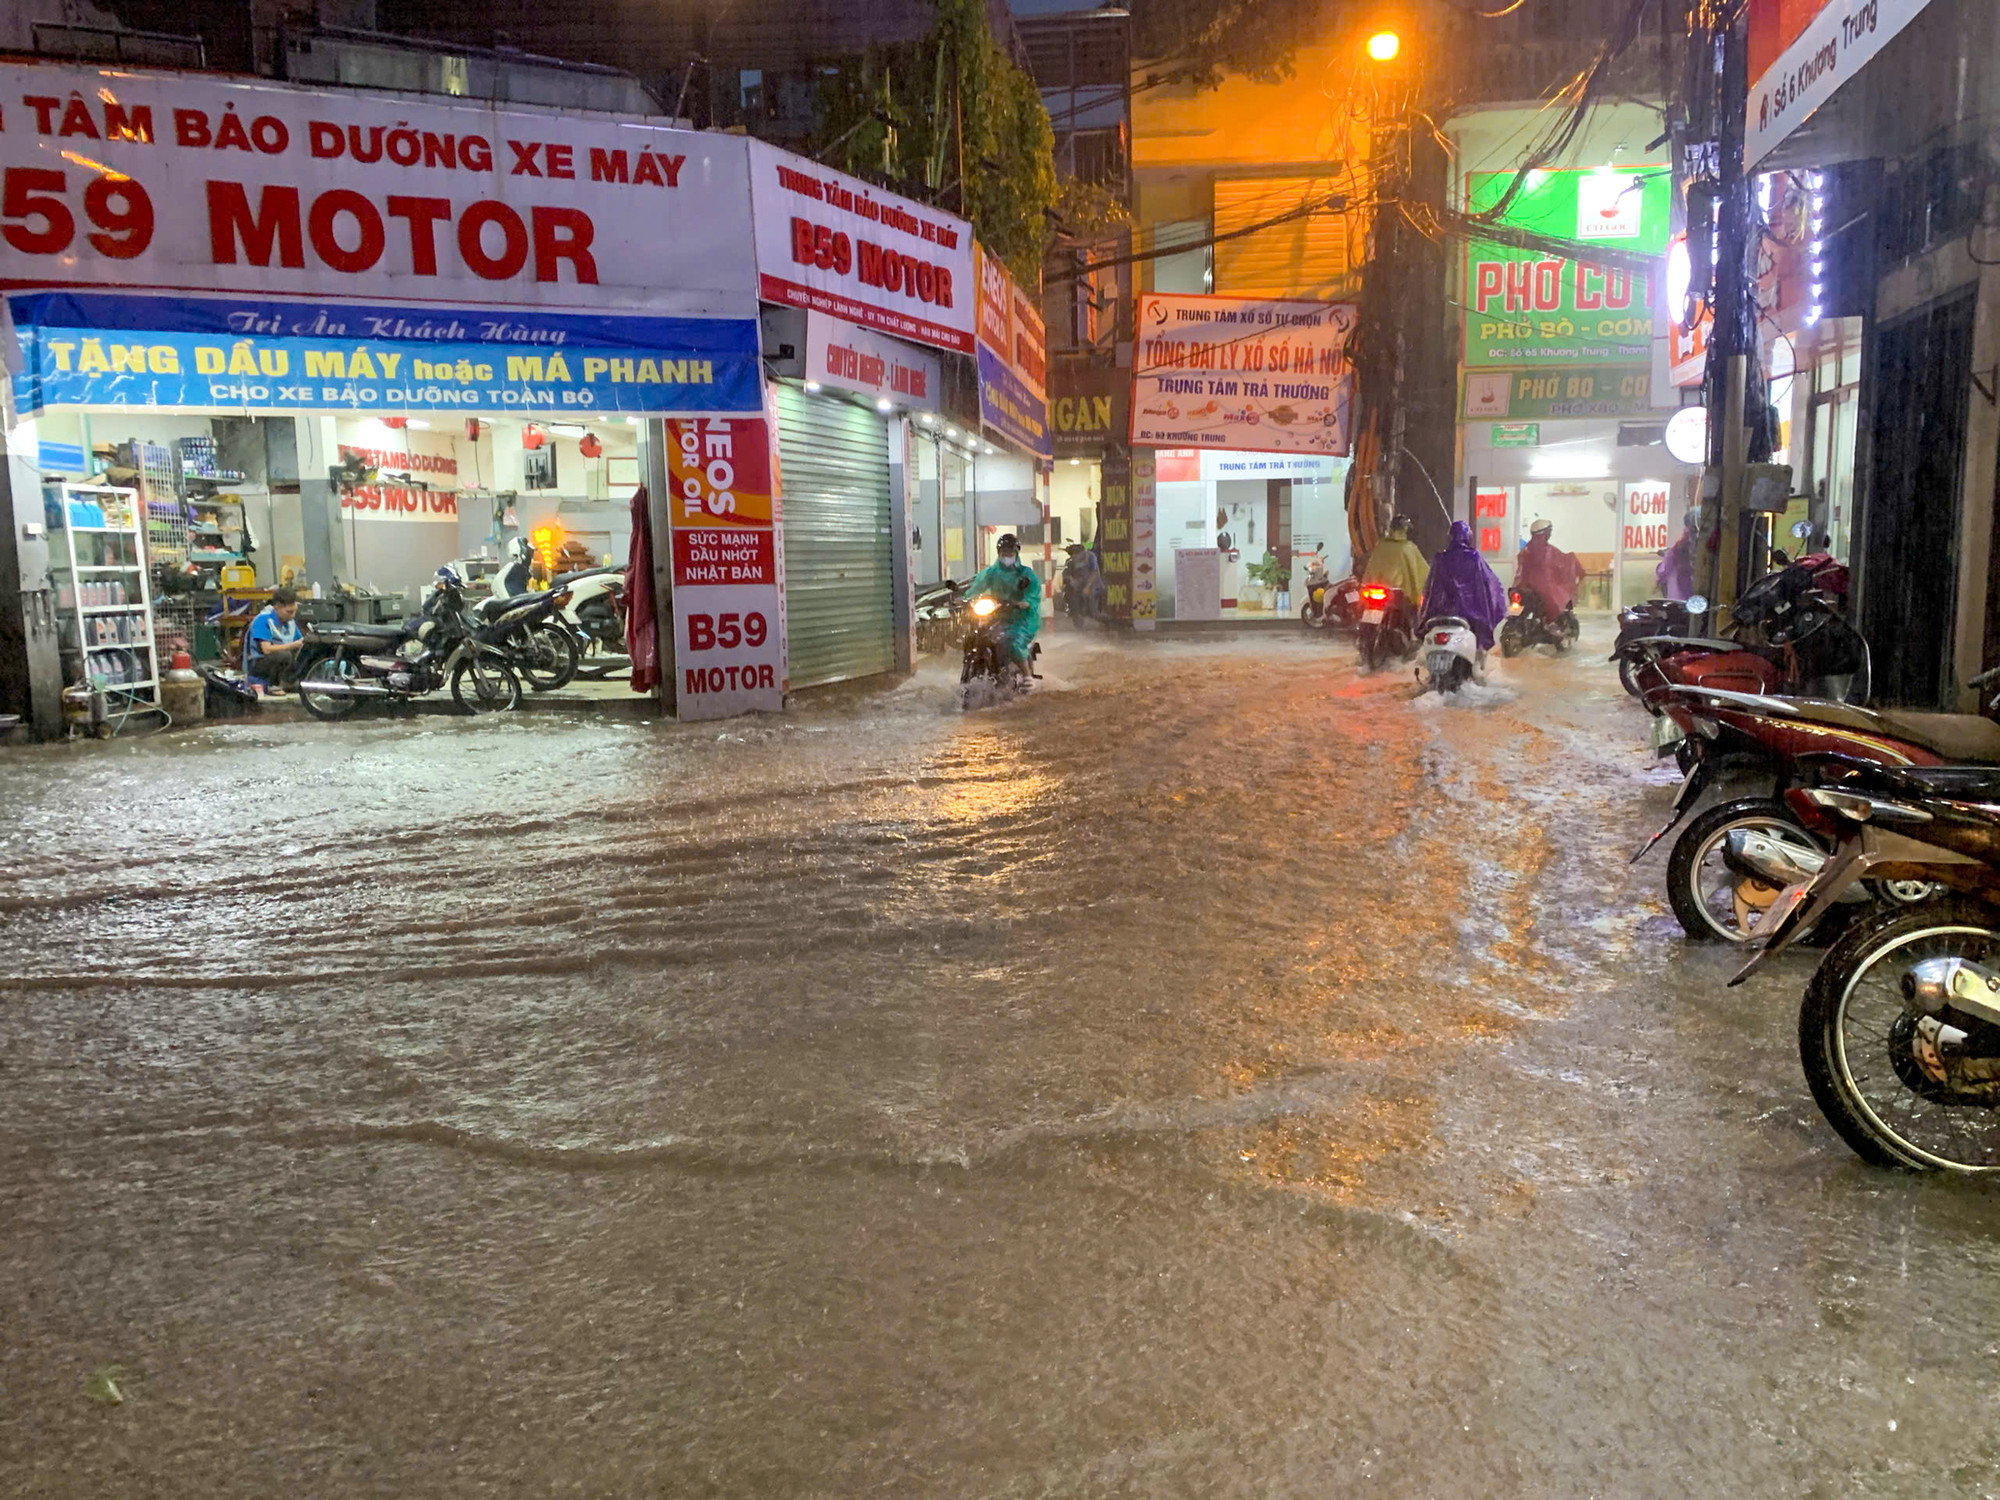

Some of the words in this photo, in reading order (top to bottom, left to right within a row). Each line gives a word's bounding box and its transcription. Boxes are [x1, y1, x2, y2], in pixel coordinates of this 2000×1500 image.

[1774, 72, 1787, 118] Số
[1789, 74, 1795, 103] 6
[1797, 36, 1837, 97] Khương
[1842, 0, 1878, 49] Trung
[23, 90, 155, 145] TÂM
[172, 101, 290, 154] BẢO
[309, 120, 493, 172] DƯỠNG
[507, 140, 576, 180] XE
[589, 144, 687, 187] MÁY
[776, 165, 824, 201] TRUNG
[824, 180, 853, 212] TÂM
[854, 189, 880, 221] BẢO
[920, 219, 936, 242] XE
[206, 180, 600, 286] MOTOR
[791, 216, 852, 276] B59
[857, 239, 953, 309] MOTOR
[1476, 252, 1567, 313] PHỞ
[227, 311, 282, 334] Tri
[363, 314, 466, 340] Khách
[480, 320, 567, 346] Hàng
[1176, 309, 1211, 322] TRUNG
[1214, 309, 1237, 323] TÂM
[1258, 309, 1272, 325] SỐ
[1480, 316, 1533, 340] PHỞ
[48, 337, 180, 378] TẶNG
[304, 345, 402, 379] MÁY
[413, 358, 493, 386] hoặc
[506, 351, 572, 382] MÁ
[583, 357, 714, 384] PHANH
[1145, 330, 1186, 368] TỔNG
[1243, 335, 1265, 372] XỔ
[1268, 337, 1290, 373] SỐ
[1294, 341, 1315, 375] HÀ
[1582, 346, 1610, 357] Trung
[210, 385, 269, 400] CHO
[278, 386, 314, 401] XE
[322, 382, 378, 402] BẢO
[386, 386, 479, 404] DƯỠNG
[562, 387, 594, 408] BỘ
[1158, 378, 1204, 395] TRUNG
[1208, 378, 1238, 397] TÂM
[1243, 379, 1269, 398] TRẢ
[1274, 380, 1330, 400] THƯỞNG
[1519, 372, 1562, 400] PHỞ
[1201, 434, 1226, 443] TRUNG
[384, 486, 457, 515] MOTOR
[683, 477, 702, 518] OIL
[688, 531, 718, 545] SỨC
[721, 533, 759, 548] MẠNH
[1624, 524, 1667, 549] RANG
[690, 546, 718, 561] DẦU
[722, 546, 758, 561] NHỚT
[686, 564, 728, 582] NHẬT
[731, 562, 763, 580] BẢN
[687, 612, 767, 651] B59
[685, 664, 775, 694] MOTOR
